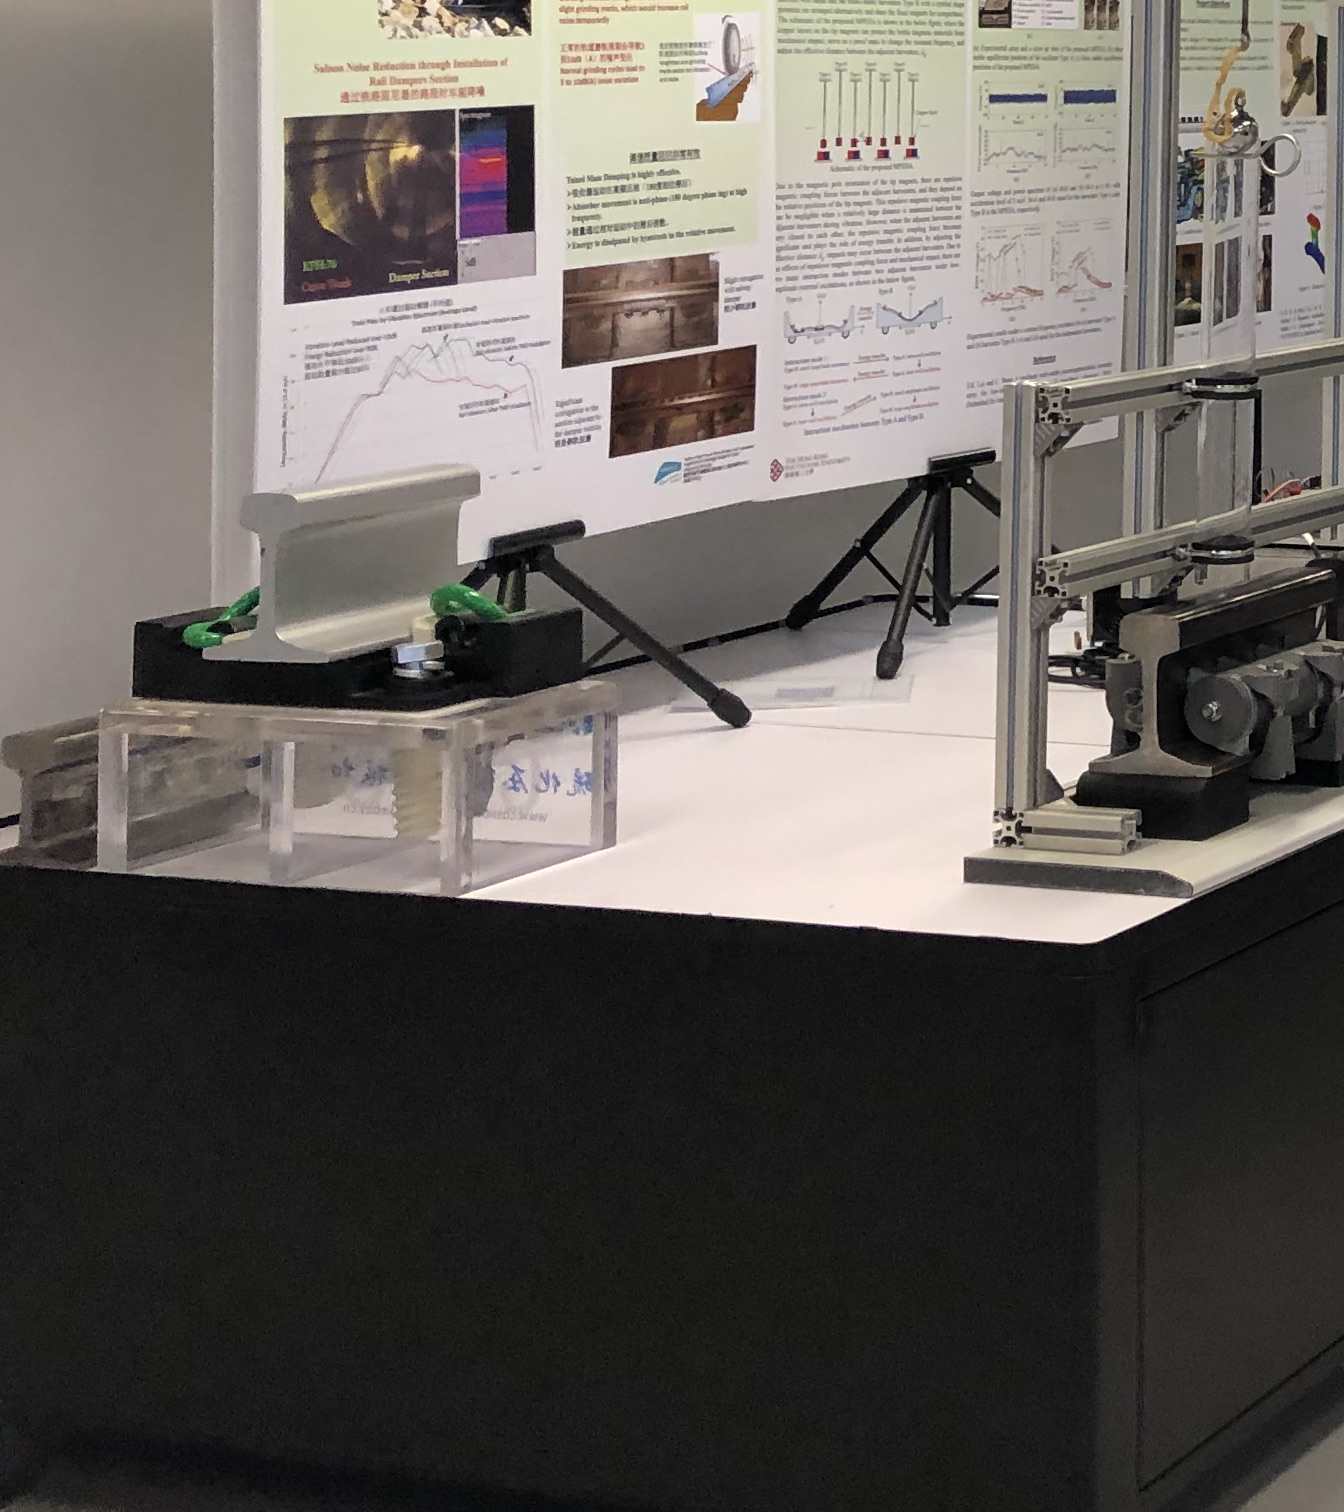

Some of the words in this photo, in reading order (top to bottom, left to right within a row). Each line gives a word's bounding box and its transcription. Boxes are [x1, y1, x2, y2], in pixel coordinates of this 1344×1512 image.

[314, 62, 344, 72] Saloon
[346, 62, 370, 71] Noise
[372, 60, 415, 71] Reduction
[418, 59, 450, 70] through
[453, 58, 498, 68] Installation
[500, 58, 508, 67] of
[369, 76, 387, 85] Rail
[389, 74, 427, 87] Dampers
[430, 73, 459, 83] Section
[388, 270, 419, 284] Damper
[420, 267, 449, 279] Section
